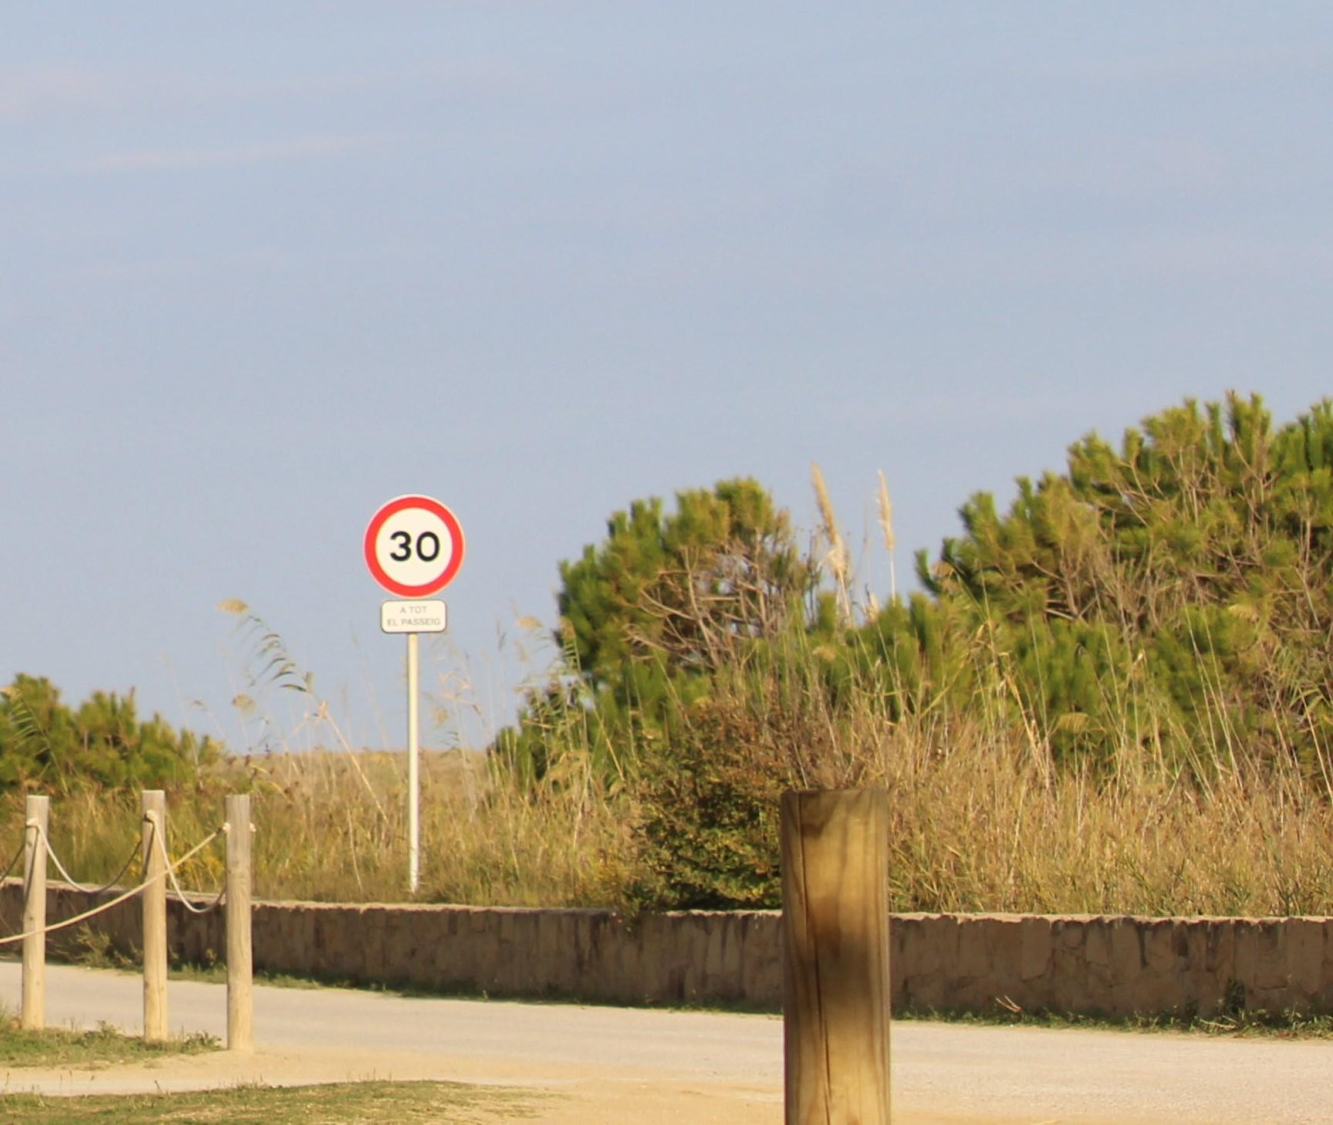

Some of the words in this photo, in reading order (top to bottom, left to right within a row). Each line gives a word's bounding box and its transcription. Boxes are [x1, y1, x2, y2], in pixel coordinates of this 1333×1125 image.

[390, 531, 440, 562] 30
[400, 606, 407, 614] A
[409, 605, 427, 614] TOT
[387, 618, 398, 626] EL
[401, 617, 441, 626] PASSEIG
